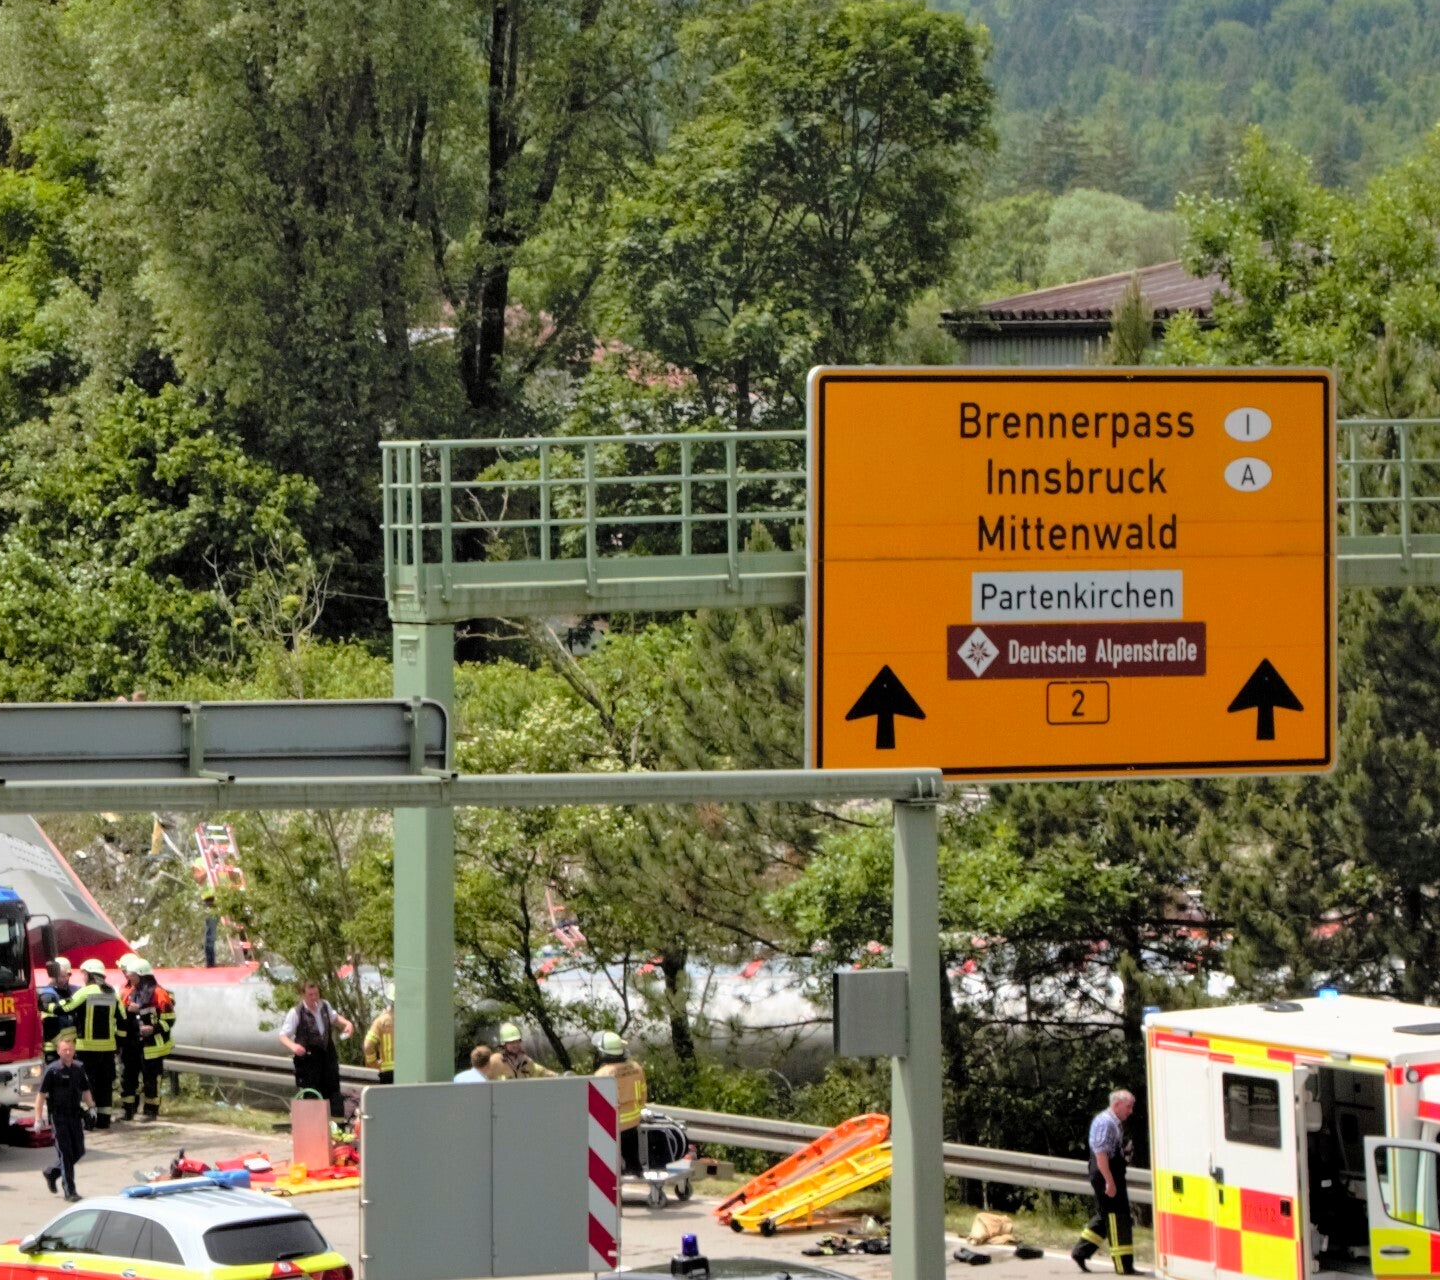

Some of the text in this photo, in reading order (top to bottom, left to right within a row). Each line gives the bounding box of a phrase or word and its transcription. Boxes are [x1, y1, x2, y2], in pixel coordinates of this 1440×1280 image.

[959, 401, 1195, 448] Brennerpass
[986, 457, 1167, 495] Innsbruck
[1240, 463, 1256, 486] A
[977, 513, 1177, 551] Mittenwald
[980, 581, 1174, 611] Partenkirchen
[1008, 637, 1198, 669] Deutsche Alpenstraße
[1071, 689, 1085, 717] 2
